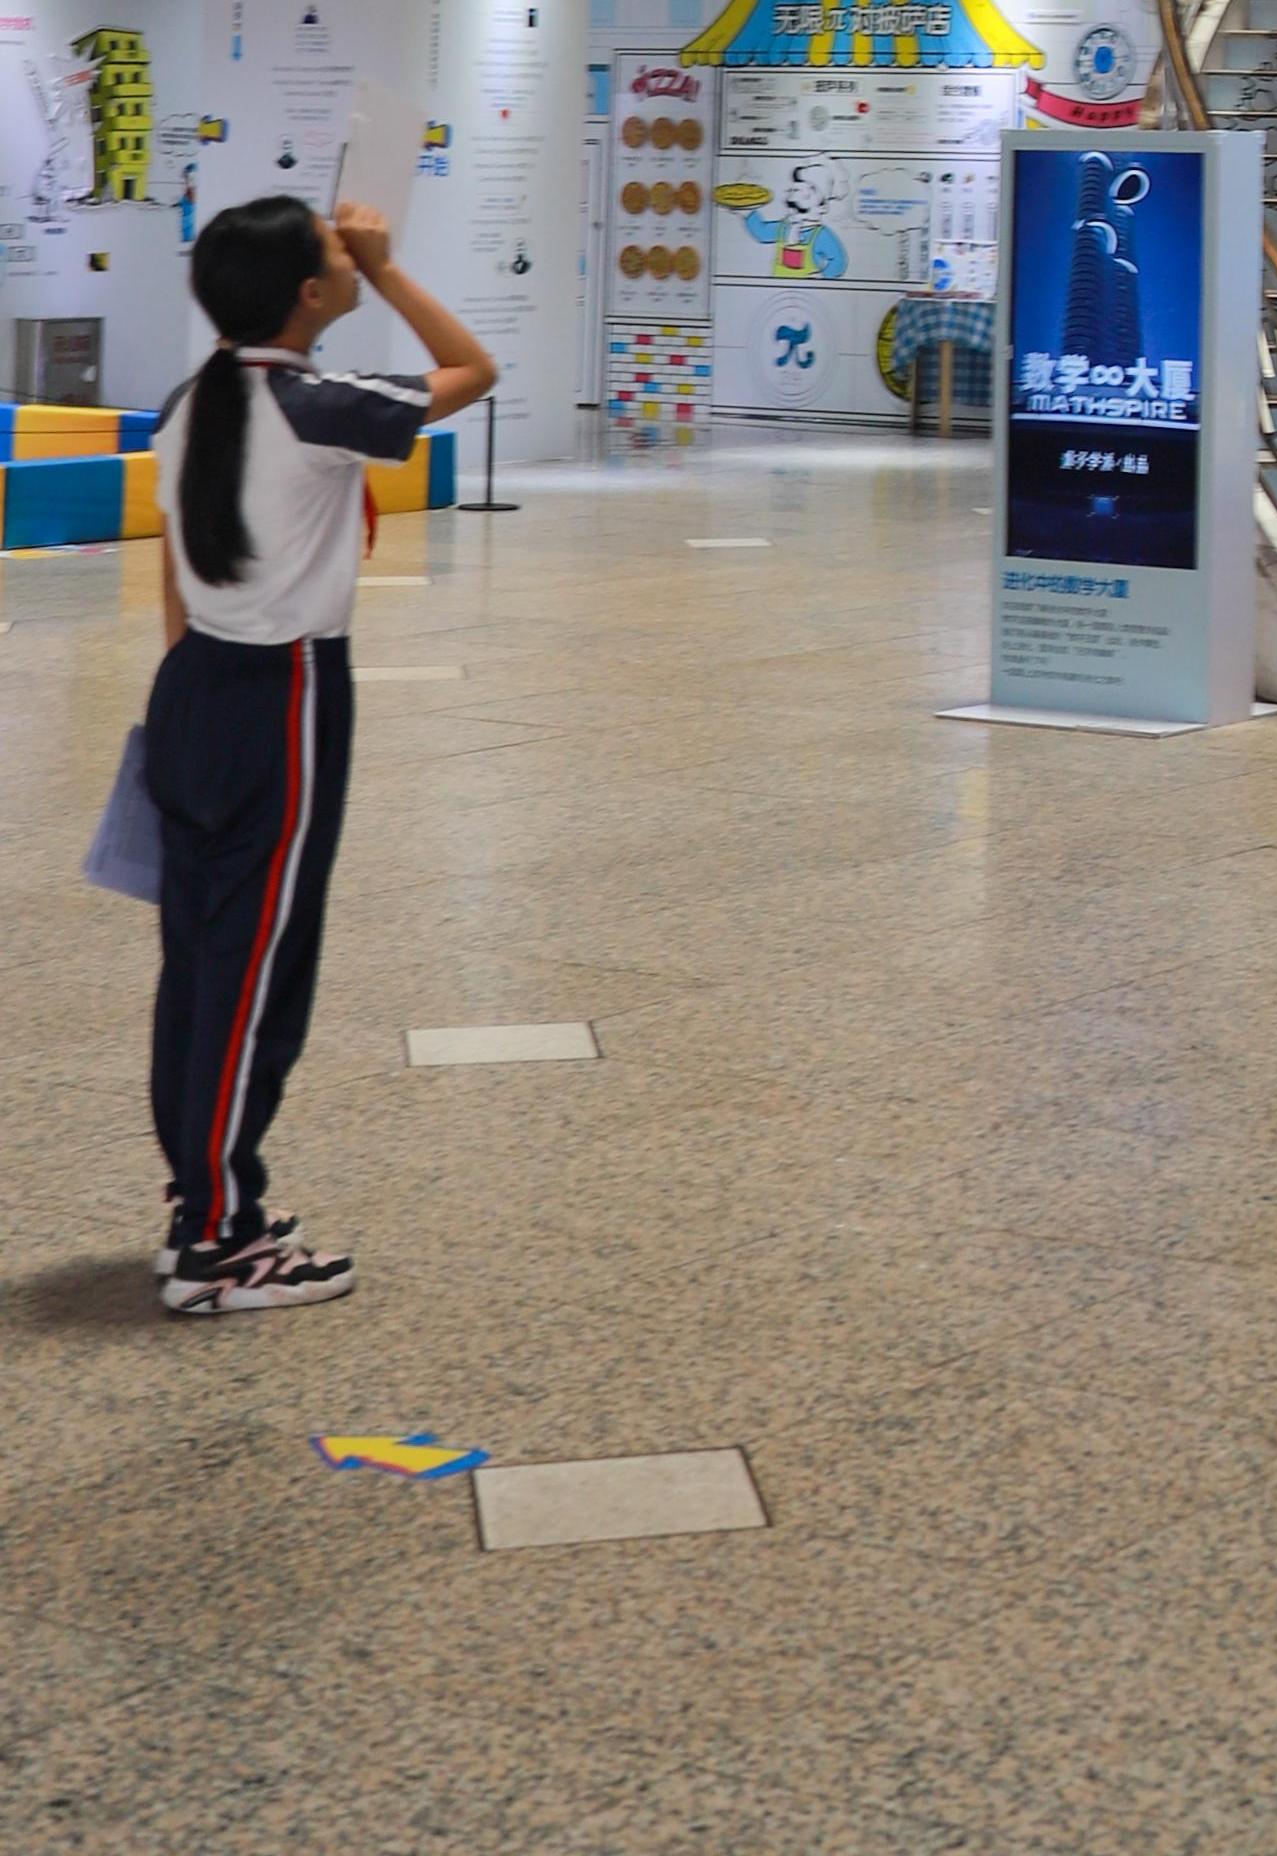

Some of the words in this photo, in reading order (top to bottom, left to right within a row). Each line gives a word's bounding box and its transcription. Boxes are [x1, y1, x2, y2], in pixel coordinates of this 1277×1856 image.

[1018, 351, 1196, 402] 数学∞大厦
[1026, 394, 1188, 421] MATHSPIRE
